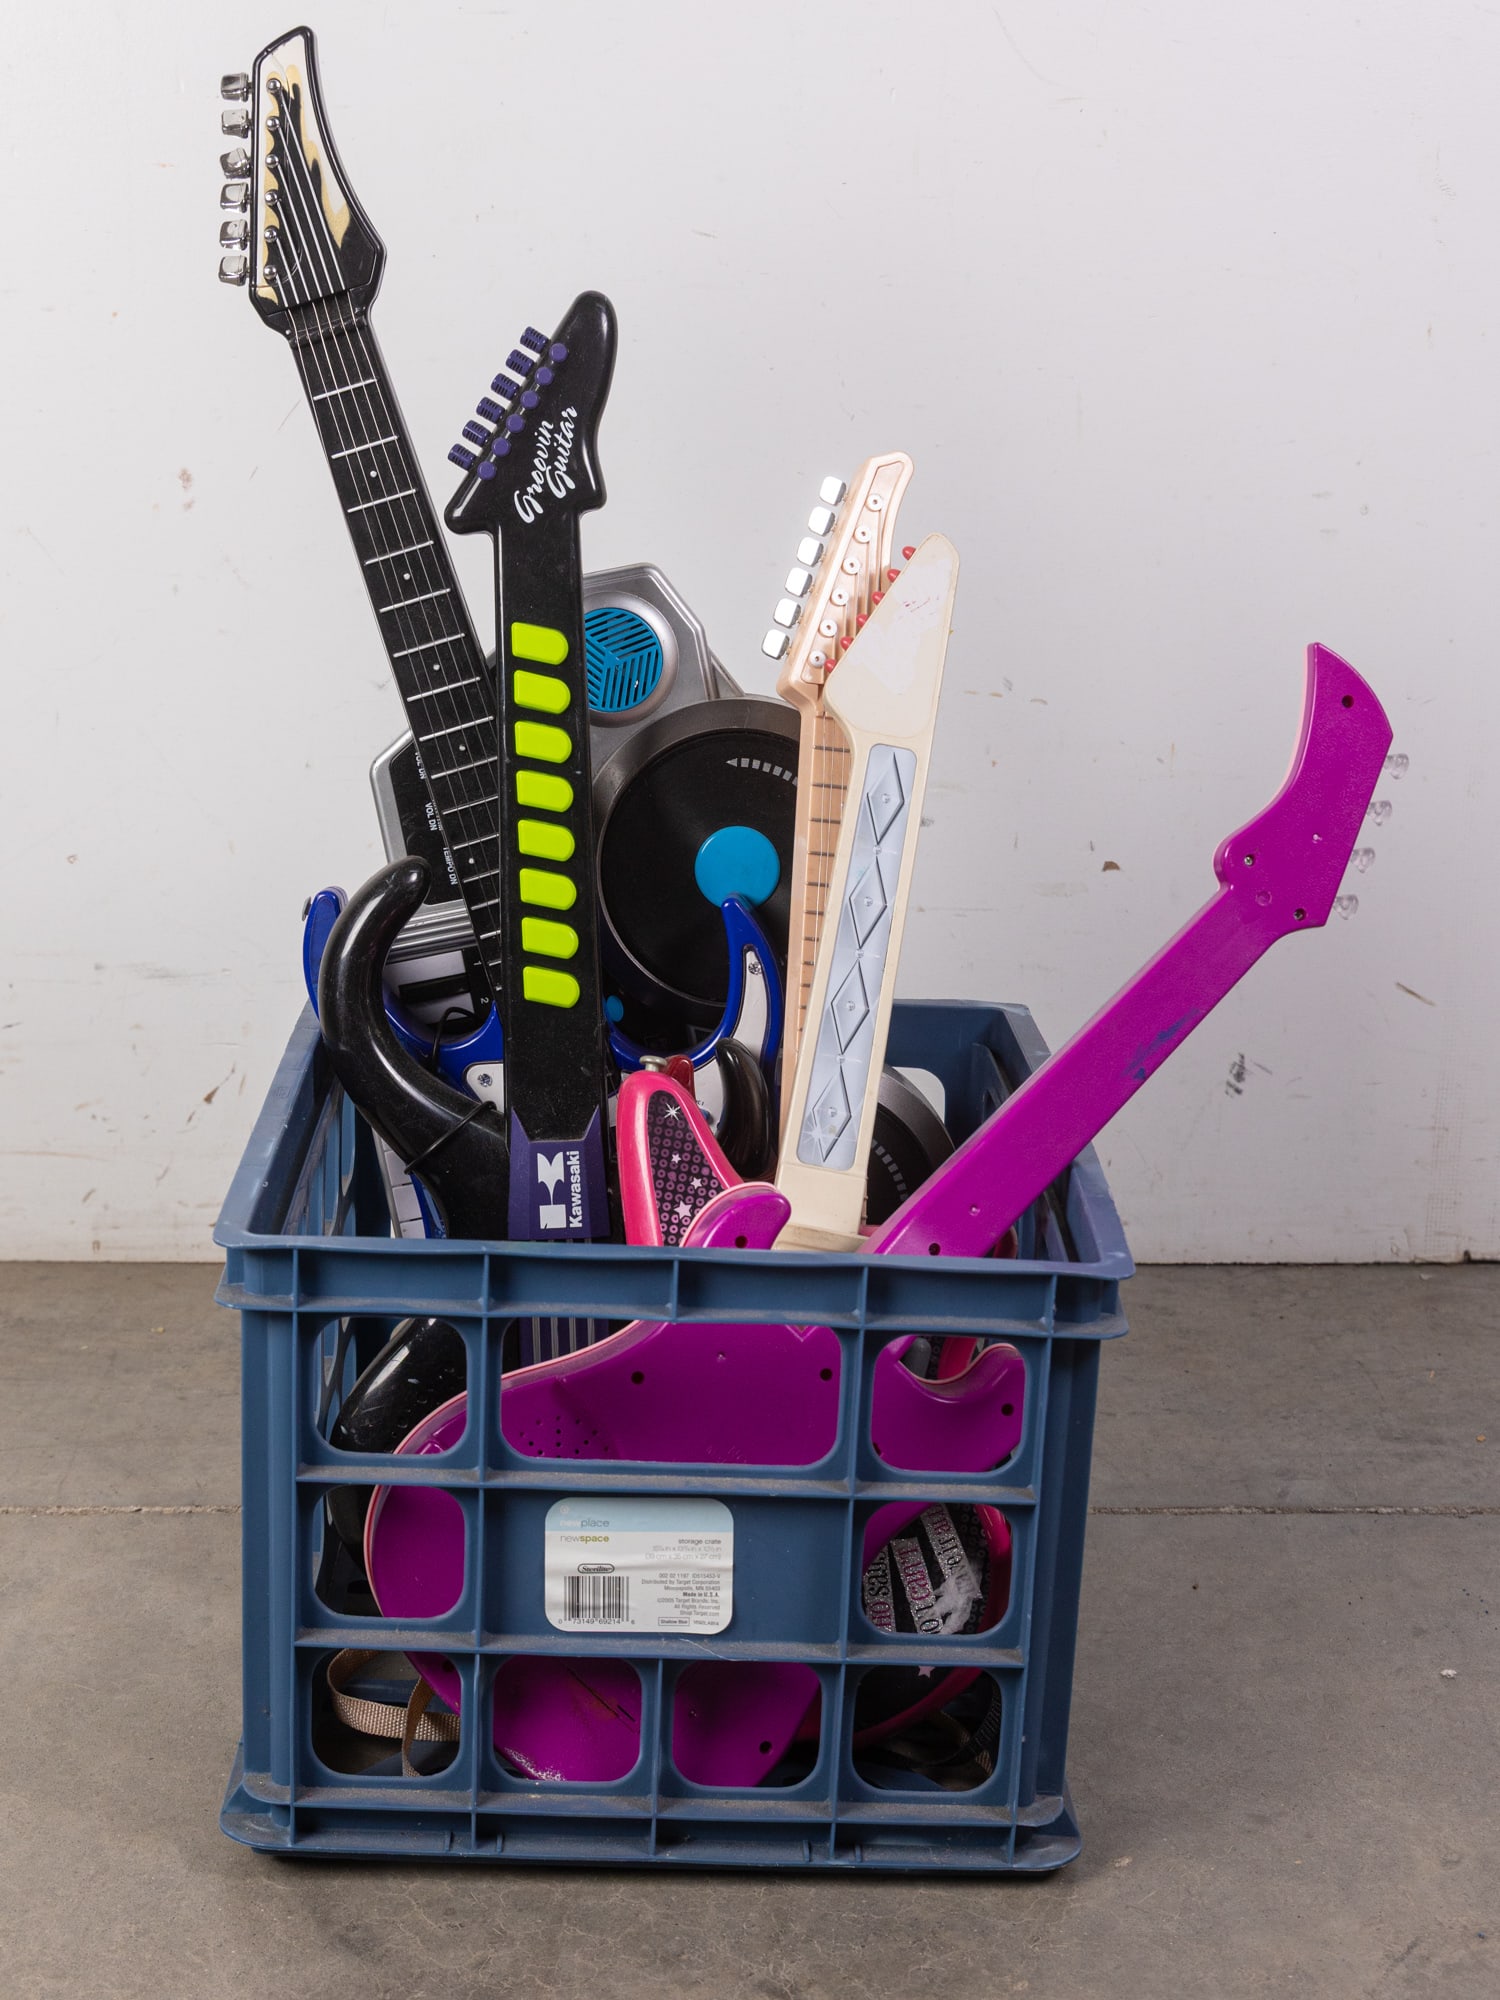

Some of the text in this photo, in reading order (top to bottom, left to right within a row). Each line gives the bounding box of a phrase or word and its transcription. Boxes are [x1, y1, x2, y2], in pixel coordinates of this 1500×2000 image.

[513, 419, 554, 524] Groovin
[545, 405, 578, 499] Guitar
[425, 802, 434, 819] VOL
[428, 818, 438, 831] DN
[443, 847, 458, 886] TEMPO DN
[566, 1150, 583, 1228] Kawasaki
[560, 1535, 610, 1545] newspace
